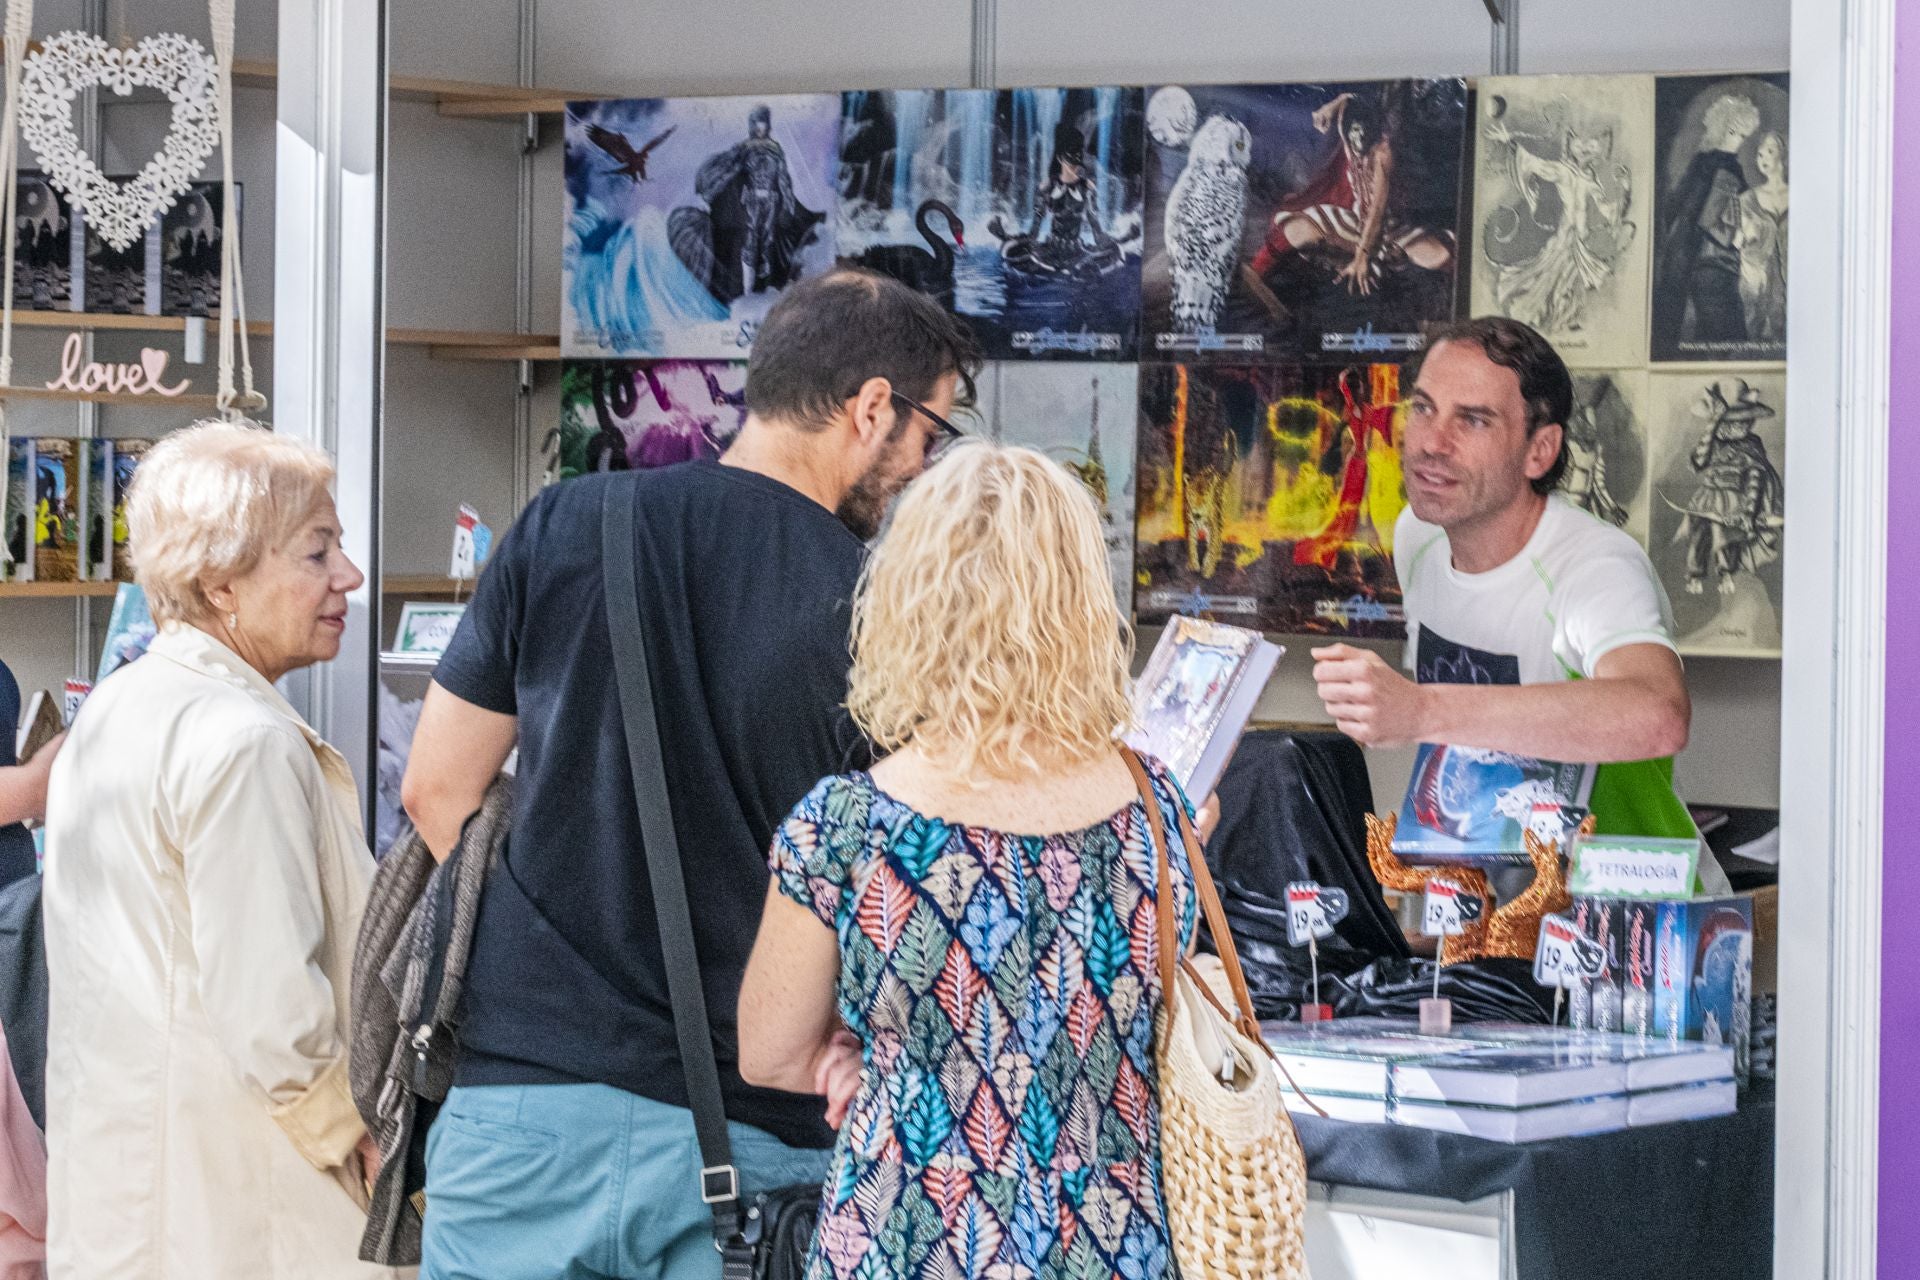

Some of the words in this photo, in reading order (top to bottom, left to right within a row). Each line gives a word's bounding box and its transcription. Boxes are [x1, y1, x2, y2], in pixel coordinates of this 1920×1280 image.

[46, 332, 192, 397] love
[1599, 862, 1679, 879] TETRALOGÍA
[1294, 910, 1309, 930] 19
[1429, 903, 1444, 922] 19
[1543, 946, 1561, 969] 19
